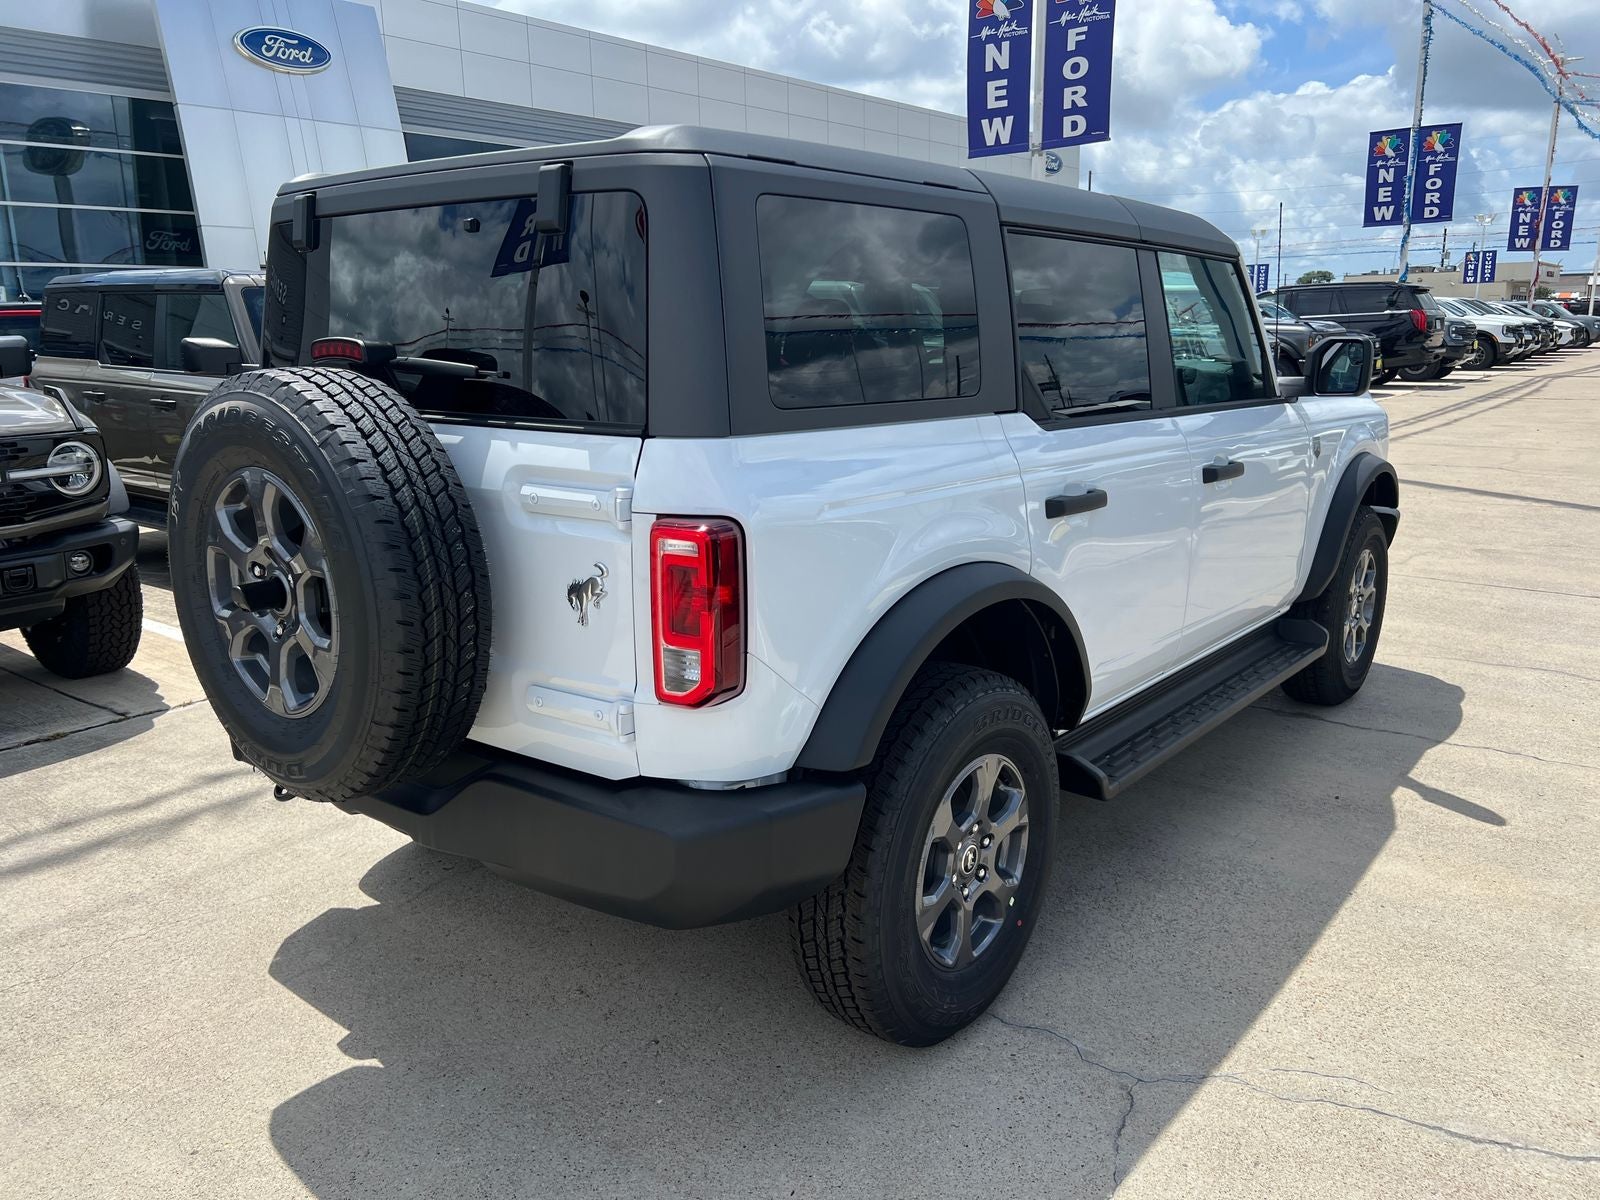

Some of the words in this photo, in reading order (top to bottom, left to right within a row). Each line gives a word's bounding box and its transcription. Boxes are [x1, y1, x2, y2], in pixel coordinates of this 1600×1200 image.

[1002, 30, 1028, 38] VICTORIA
[1083, 14, 1110, 23] VICTORIA
[261, 34, 313, 63] Ford
[981, 41, 1014, 146] NEW
[1062, 26, 1089, 138] FORD
[1373, 167, 1395, 221] NEW
[1423, 163, 1443, 218] FORD
[145, 230, 191, 252] Ford
[1514, 212, 1531, 248] NEW
[1549, 211, 1565, 248] FORD
[1466, 264, 1475, 283] NEW
